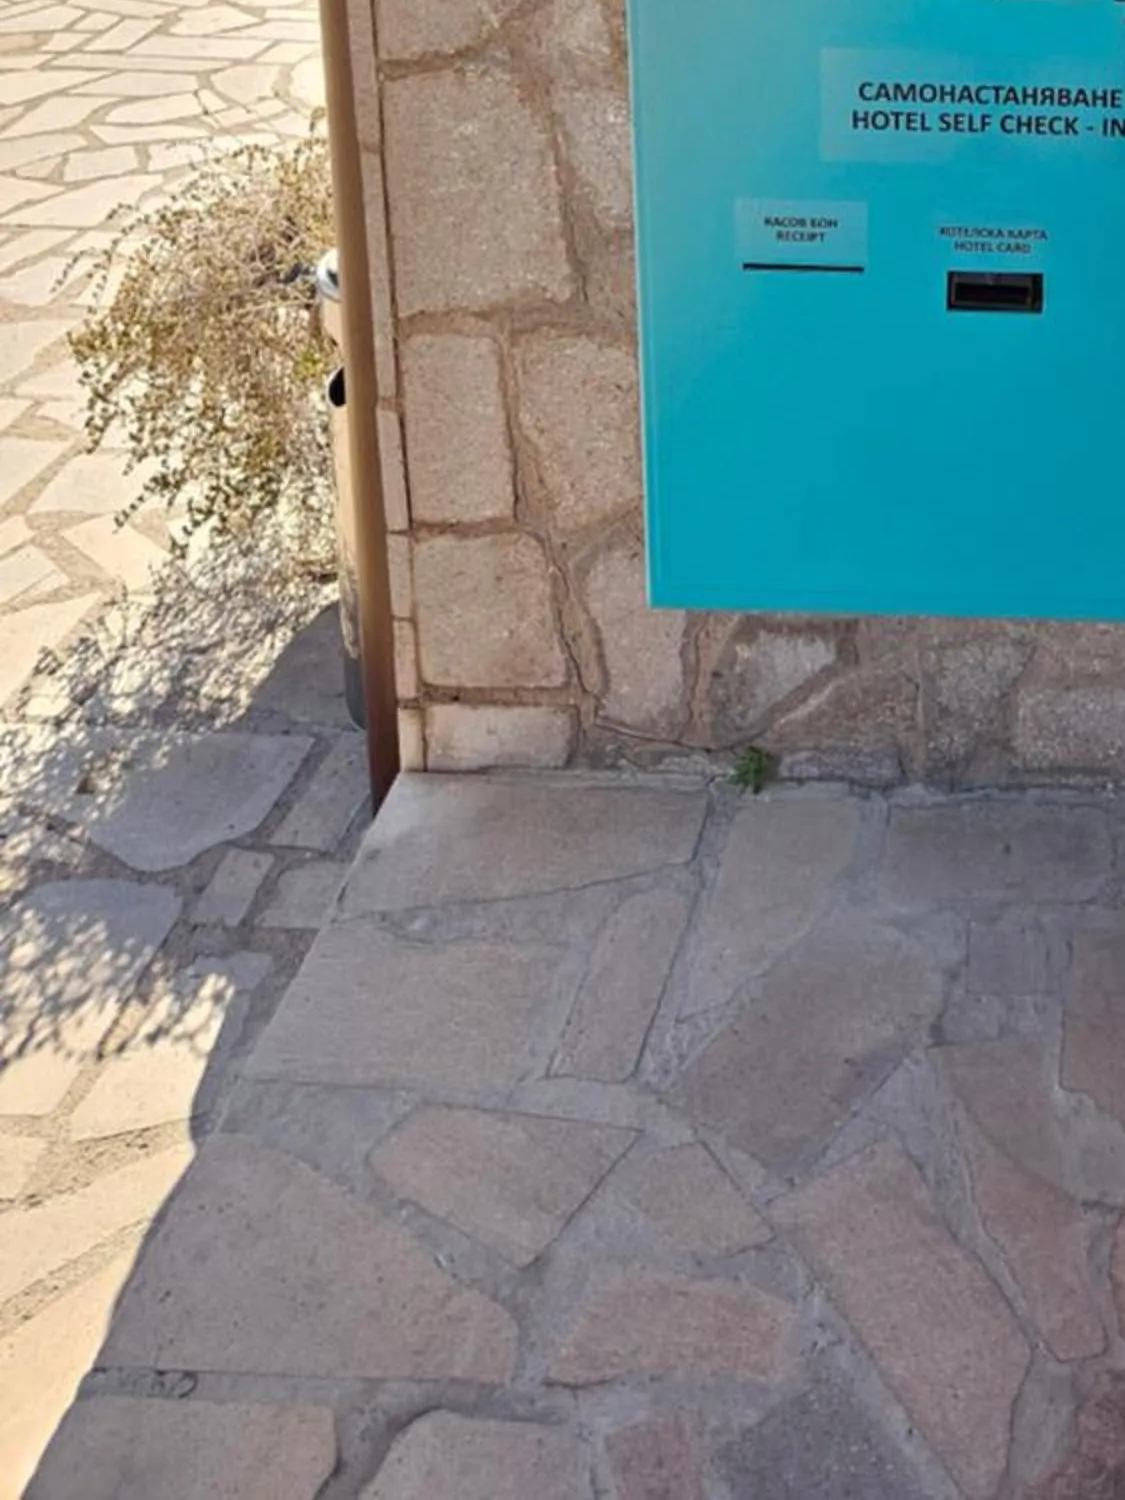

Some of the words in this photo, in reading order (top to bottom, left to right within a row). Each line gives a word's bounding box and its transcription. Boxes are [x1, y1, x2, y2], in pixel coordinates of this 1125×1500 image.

[858, 81, 1123, 109] САМОНАСТАНЯВАНЕ
[852, 110, 931, 133] HOTEL
[938, 111, 992, 134] SELF
[1000, 113, 1079, 136] CHECK
[776, 230, 825, 243] RECEIPT
[954, 241, 994, 253] HOTEL
[996, 242, 1032, 254] CARD
